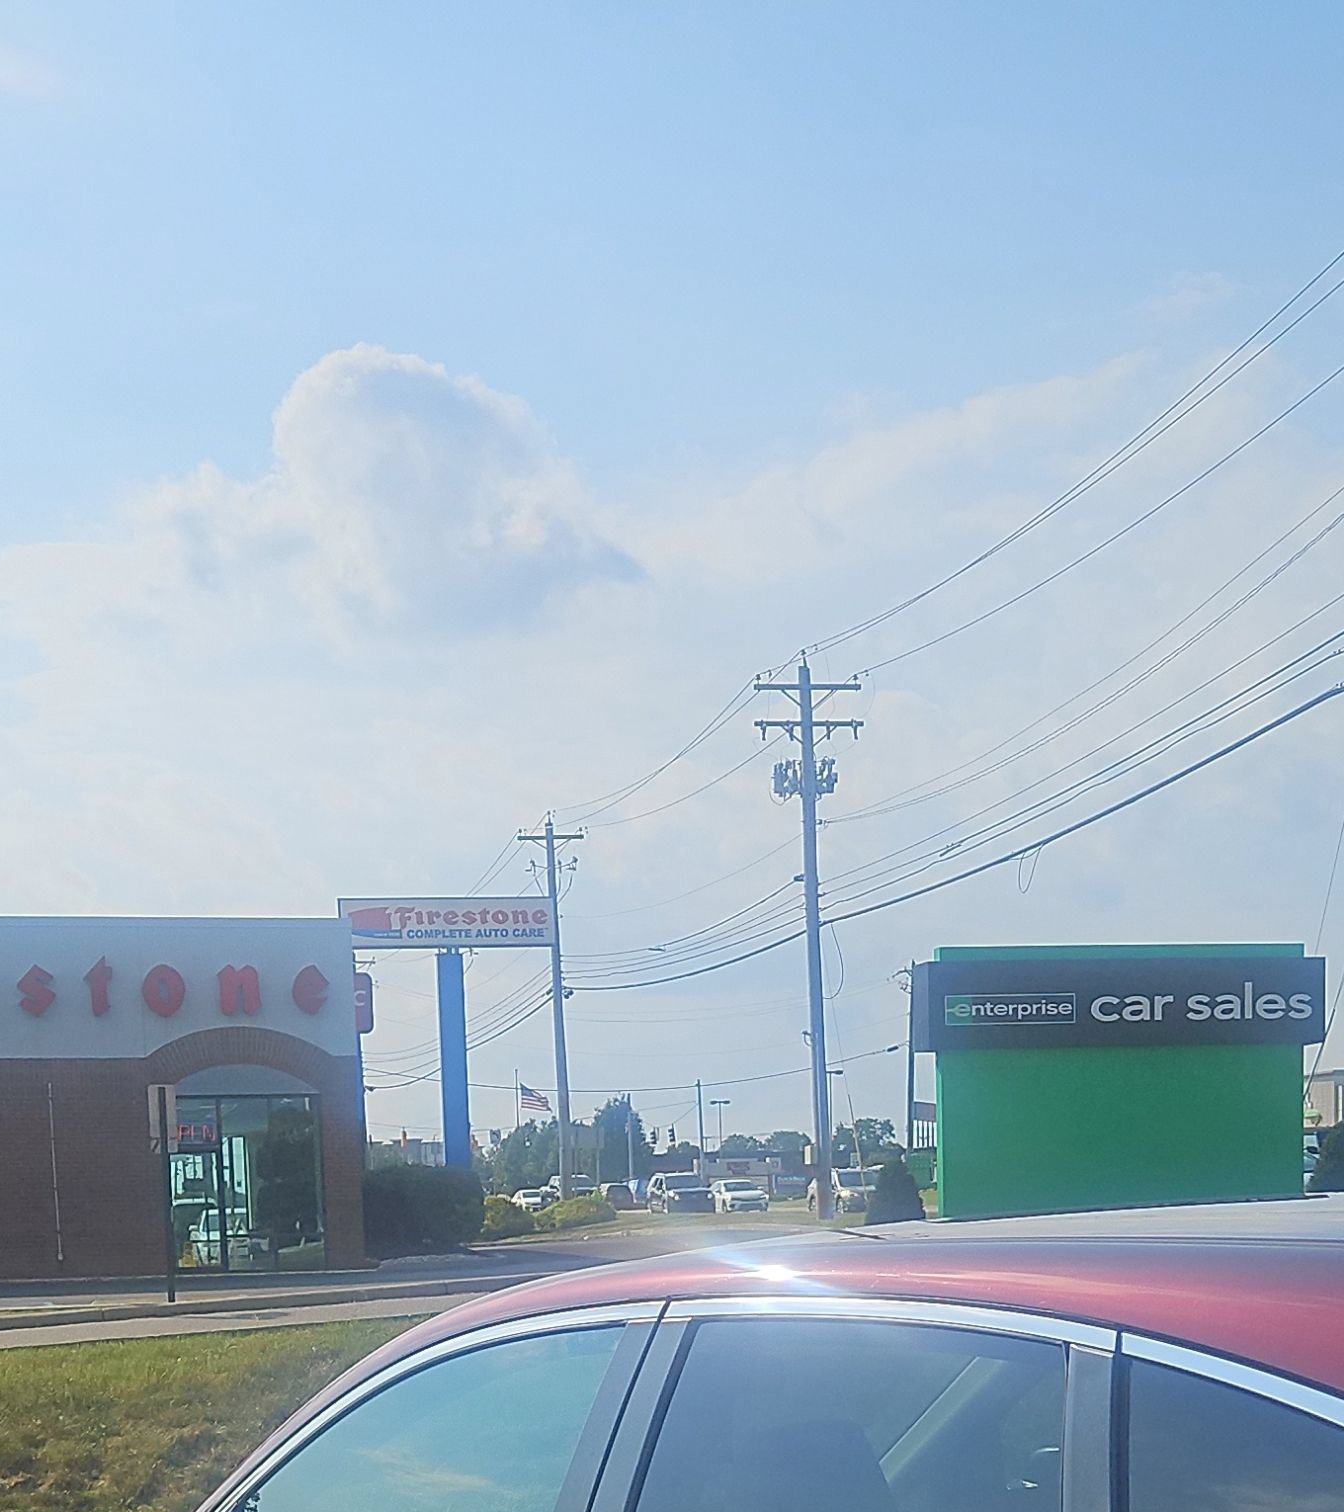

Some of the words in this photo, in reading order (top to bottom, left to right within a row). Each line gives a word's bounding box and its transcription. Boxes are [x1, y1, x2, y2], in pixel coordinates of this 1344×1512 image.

[395, 905, 548, 930] Firestone
[406, 929, 472, 939] COMPLETE
[475, 928, 509, 938] AUTO
[513, 928, 545, 938] CARE
[949, 999, 1073, 1021] enterprise
[1090, 993, 1175, 1023] car
[1186, 982, 1313, 1021] sales
